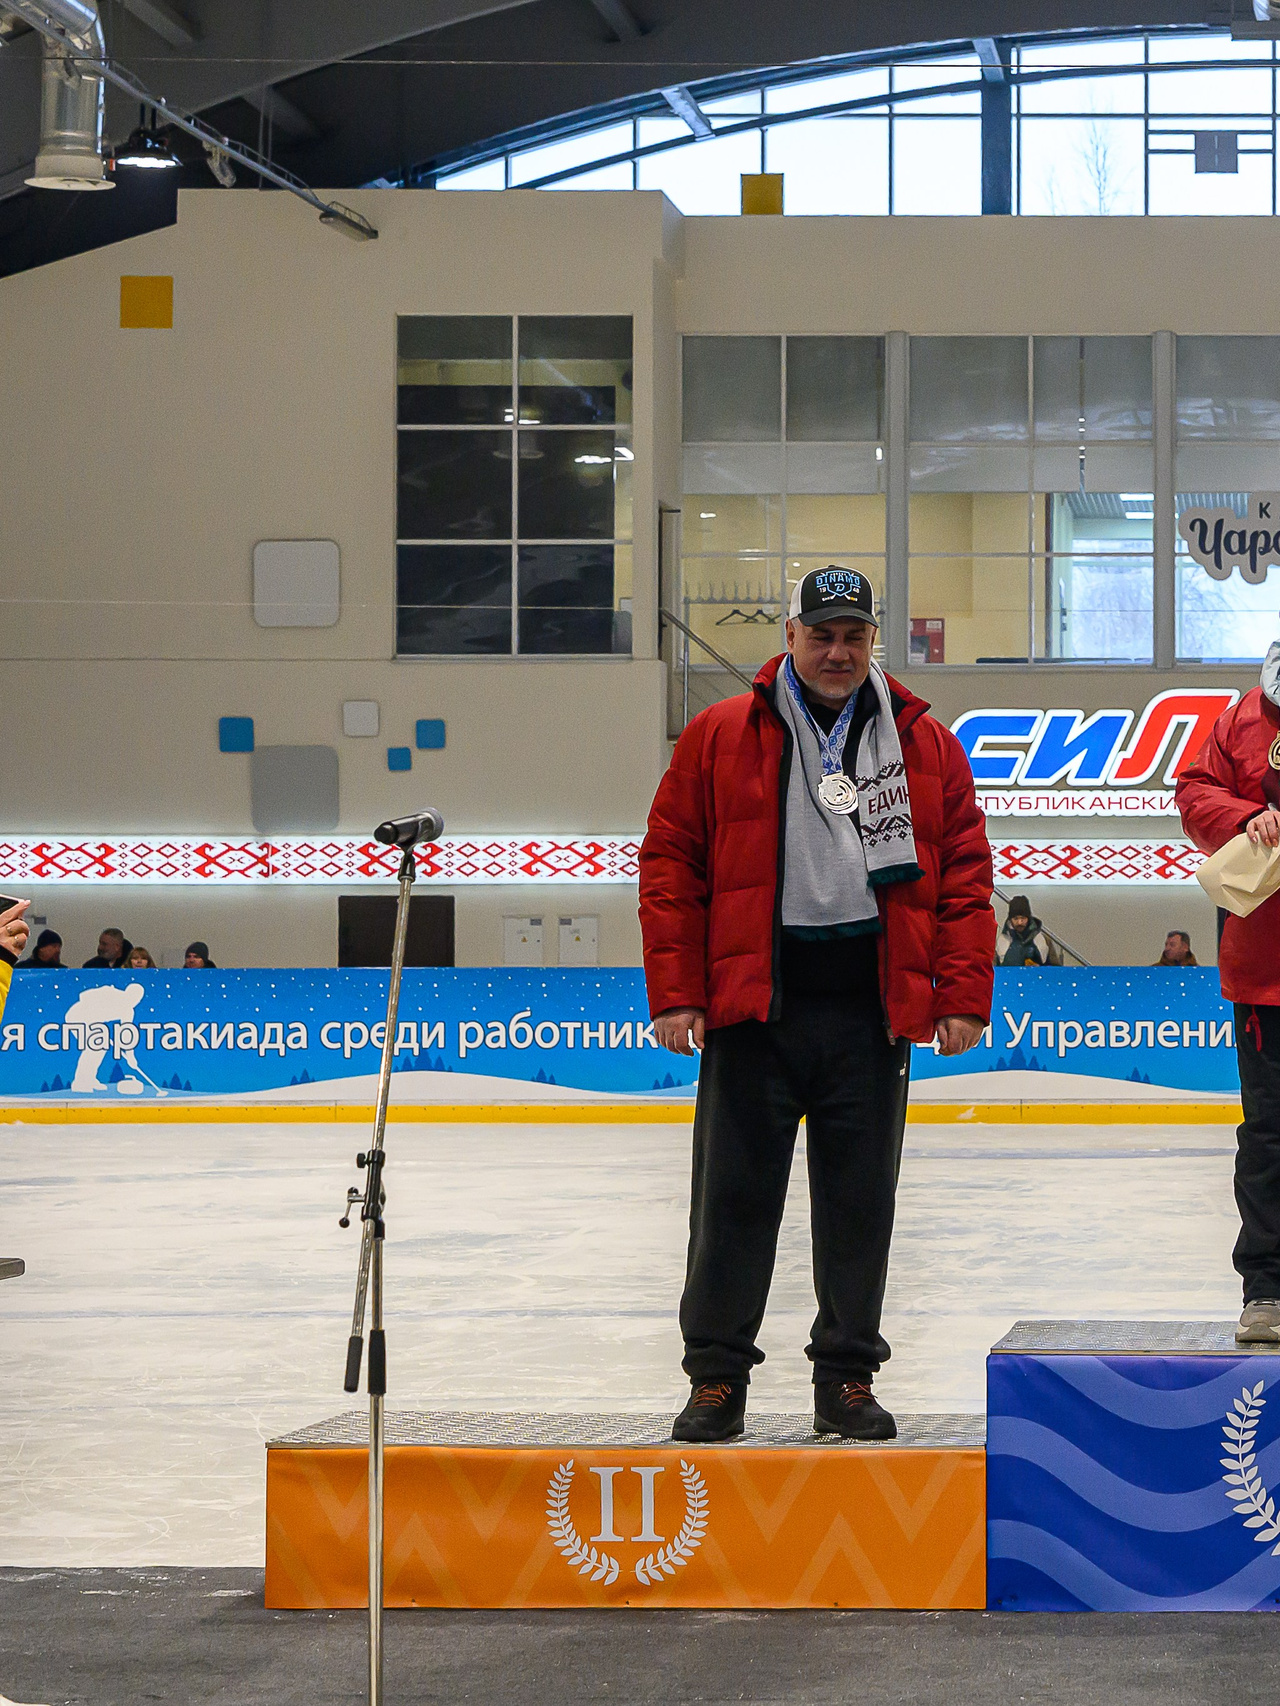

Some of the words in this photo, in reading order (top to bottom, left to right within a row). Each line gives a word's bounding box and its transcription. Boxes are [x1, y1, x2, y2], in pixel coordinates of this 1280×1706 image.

[816, 575, 861, 586] DINAMO
[950, 688, 1240, 786] СИЛ
[976, 796, 1177, 811] ПУБЛИКАНСКИ
[37, 1021, 308, 1059] спартакиада
[320, 1021, 445, 1057] среди
[459, 1010, 659, 1058] работник
[1004, 1012, 1237, 1057] Управлени
[589, 1466, 666, 1542] II
